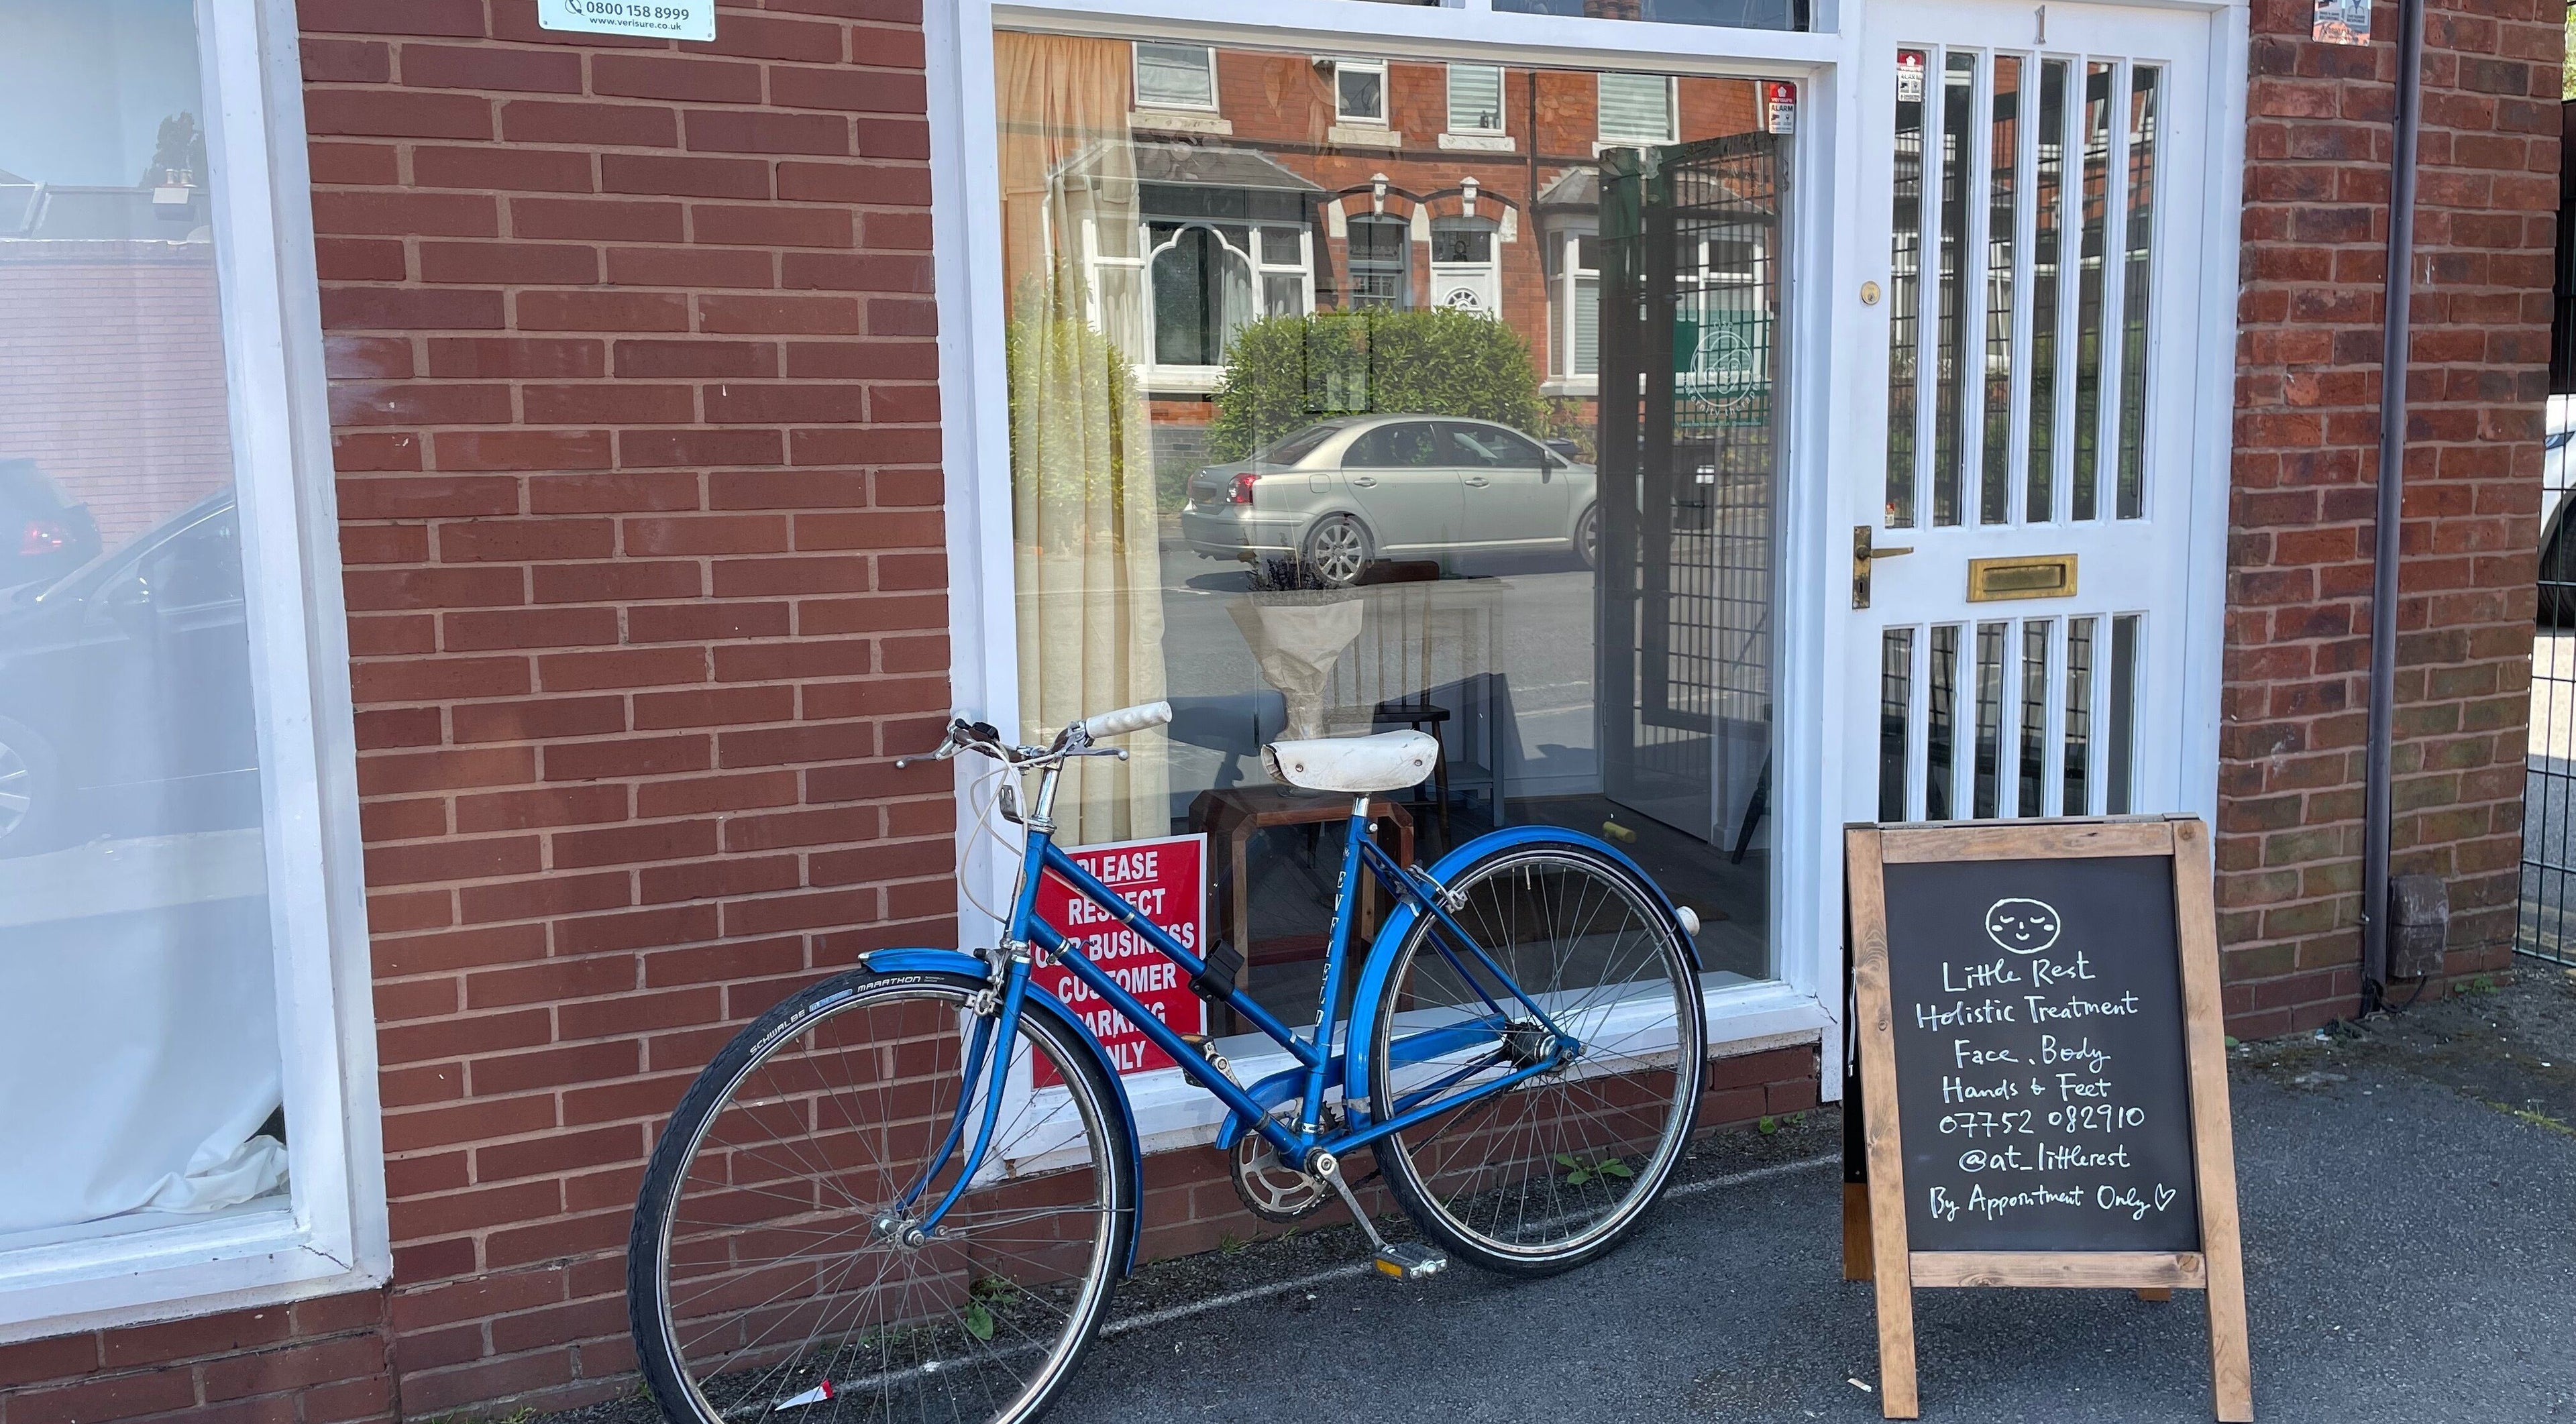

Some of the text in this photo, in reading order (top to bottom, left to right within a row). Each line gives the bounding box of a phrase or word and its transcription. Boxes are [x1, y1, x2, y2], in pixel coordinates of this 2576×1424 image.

[586, 1, 690, 20] 0800 158 8999
[589, 17, 682, 31] www.verisure.co.uk
[1713, 321, 1733, 329] rise
[857, 975, 921, 993] MARATHON
[1943, 950, 2096, 992] Little Rest
[1915, 991, 2139, 1032] Holistic Treatment
[749, 1009, 806, 1056] SCHWALBE
[1106, 1040, 1146, 1071] NLY
[2042, 1035, 2111, 1074] Body
[1942, 1076, 2019, 1103] Hands
[2055, 1073, 2112, 1102] Feet
[1939, 1105, 2145, 1138] 07752 082910
[1958, 1142, 2131, 1172] @at_littlerest
[1929, 1186, 1960, 1221] By
[2096, 1185, 2151, 1221] Only
